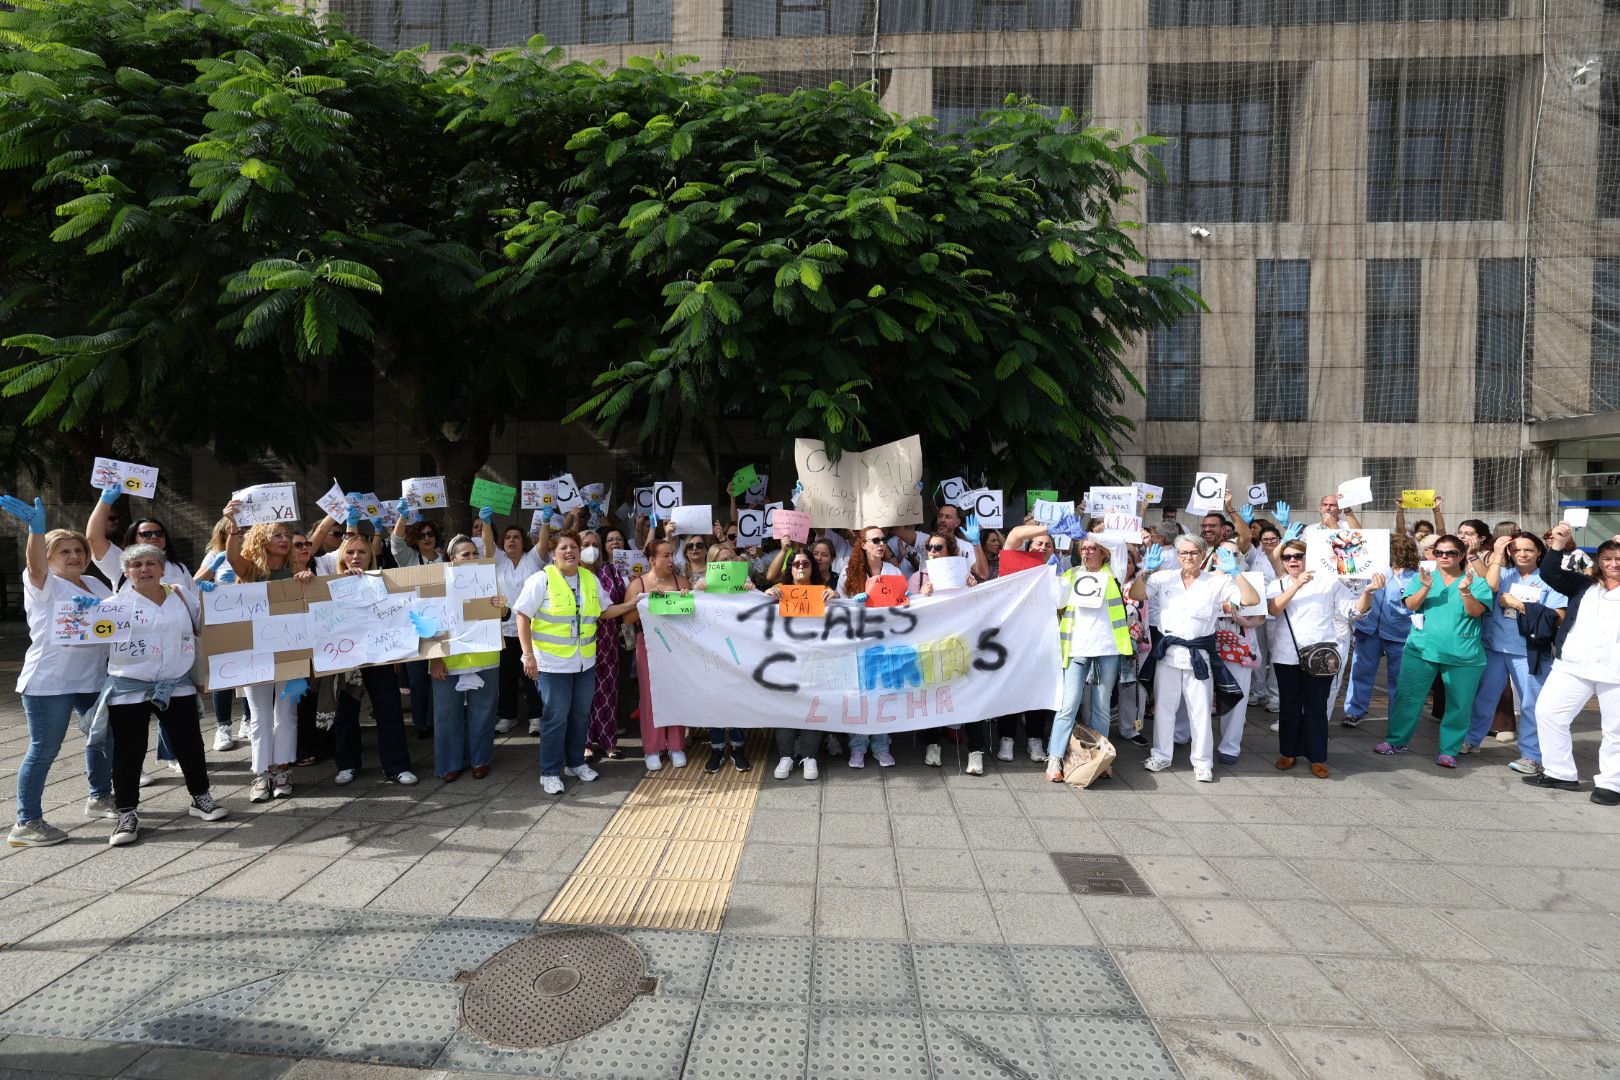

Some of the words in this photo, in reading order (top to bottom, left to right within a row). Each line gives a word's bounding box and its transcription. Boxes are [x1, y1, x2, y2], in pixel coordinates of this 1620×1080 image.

[128, 465, 152, 476] TCAE
[126, 480, 140, 488] C1
[144, 481, 155, 489] YA
[557, 480, 579, 502] C1
[1196, 476, 1223, 498] C1
[1248, 486, 1265, 499] C1
[637, 489, 653, 508] C
[655, 485, 680, 508] C1
[975, 494, 1002, 518] C1
[272, 505, 294, 520] YA
[738, 514, 762, 537] C1
[454, 571, 479, 589] C1
[720, 573, 731, 582] C1
[1074, 575, 1102, 597] C1
[790, 588, 809, 600] C1
[881, 586, 892, 595] C1
[96, 604, 126, 613] TCAE
[214, 592, 244, 612] C1
[95, 624, 112, 634] C1
[116, 621, 131, 630] YA
[737, 599, 919, 640] TCAES
[260, 622, 289, 641] C1
[113, 639, 147, 653] TCAE
[219, 653, 254, 679] C1
[804, 684, 955, 725] LUCHA
